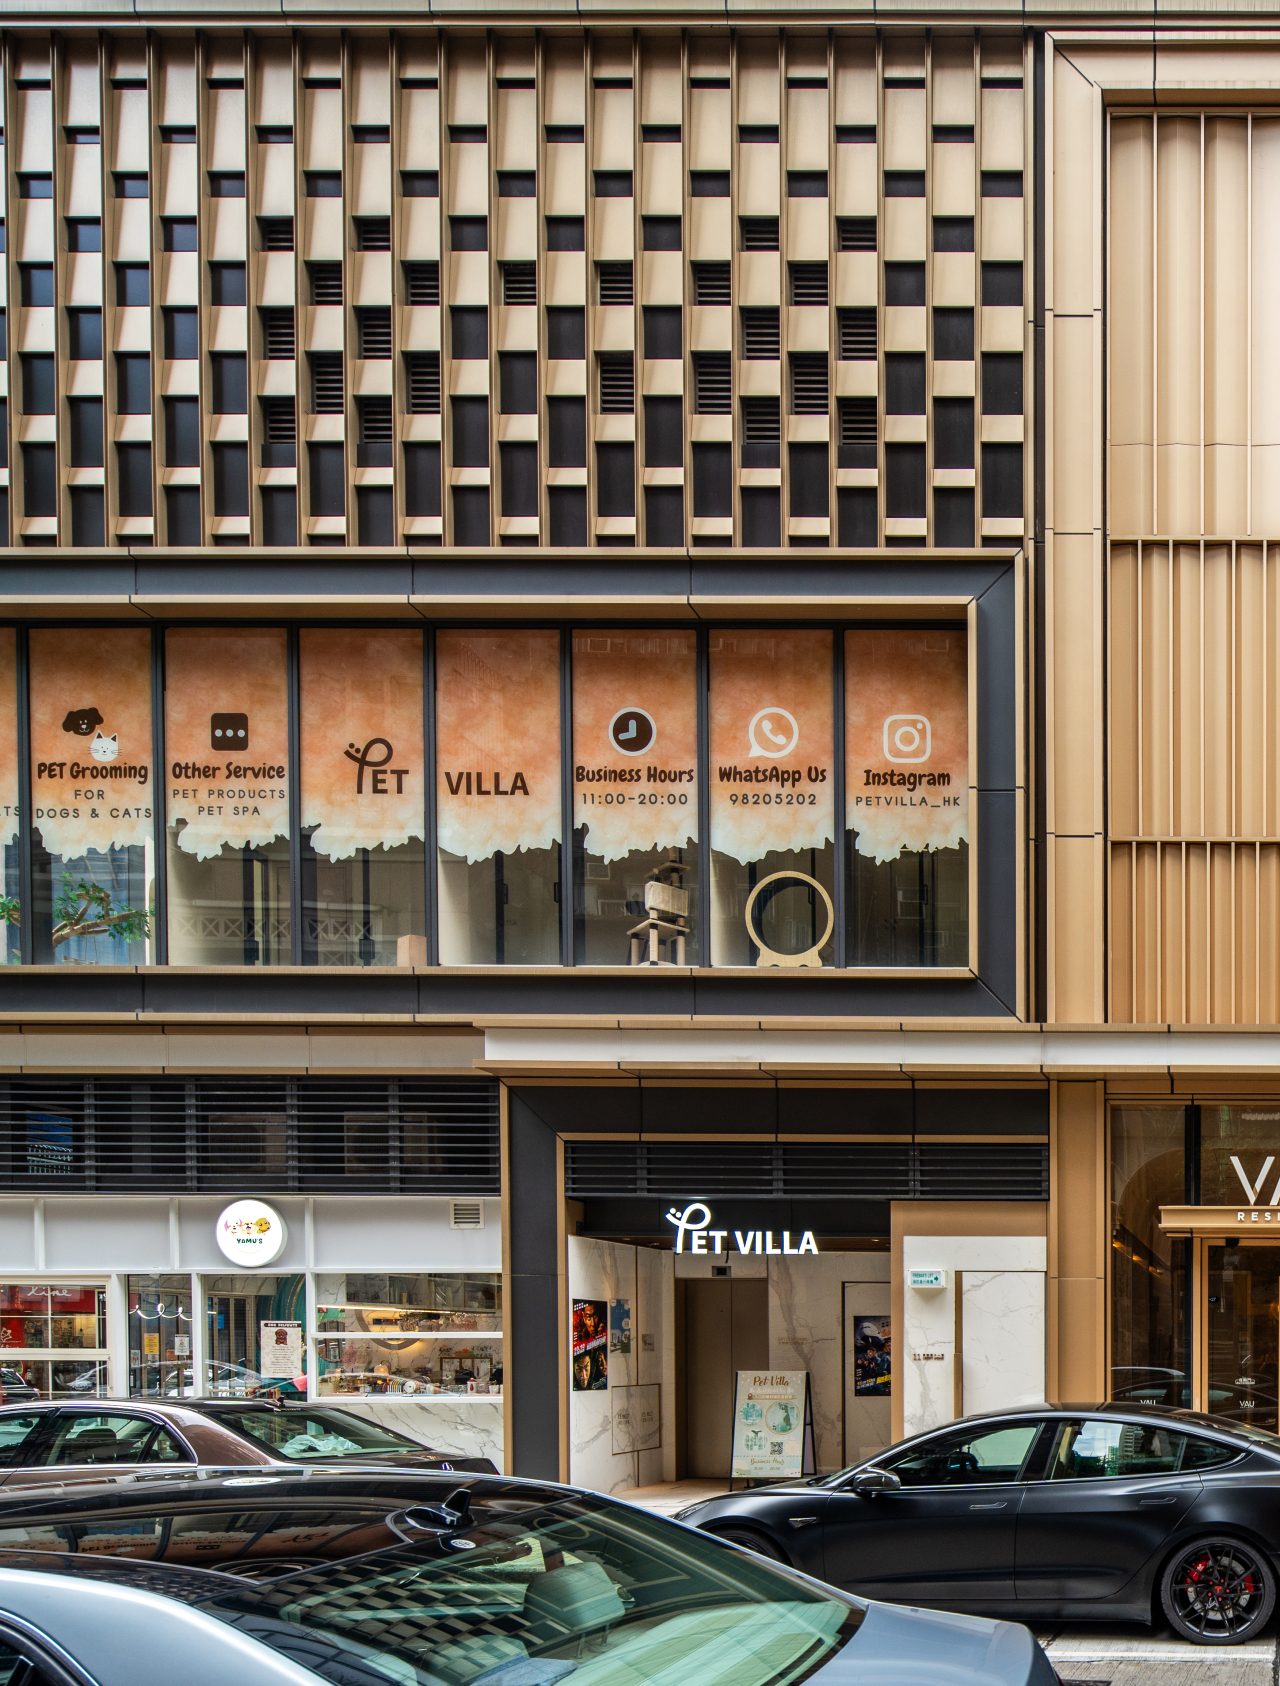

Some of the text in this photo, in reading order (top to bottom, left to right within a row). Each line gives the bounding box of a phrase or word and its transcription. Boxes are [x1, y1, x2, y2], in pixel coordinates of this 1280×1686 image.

[171, 762, 286, 780] Other Service
[343, 737, 530, 796] PET VILLA
[37, 761, 149, 785] PET Grooming
[575, 765, 694, 783] Business Hours
[718, 765, 827, 788] WhatsApp Us
[863, 769, 951, 792] Instagram
[74, 789, 105, 800] FOR
[172, 789, 286, 799] PET PRODUCTS
[582, 793, 688, 805] 11:00-20:00
[729, 793, 817, 805] 98205202
[855, 796, 961, 808] PETVILLA_HK
[36, 808, 153, 819] DOGS & CATS
[198, 806, 261, 816] PET SPA
[665, 1202, 819, 1255] PET VILLA
[1239, 1400, 1255, 1408] VAU
